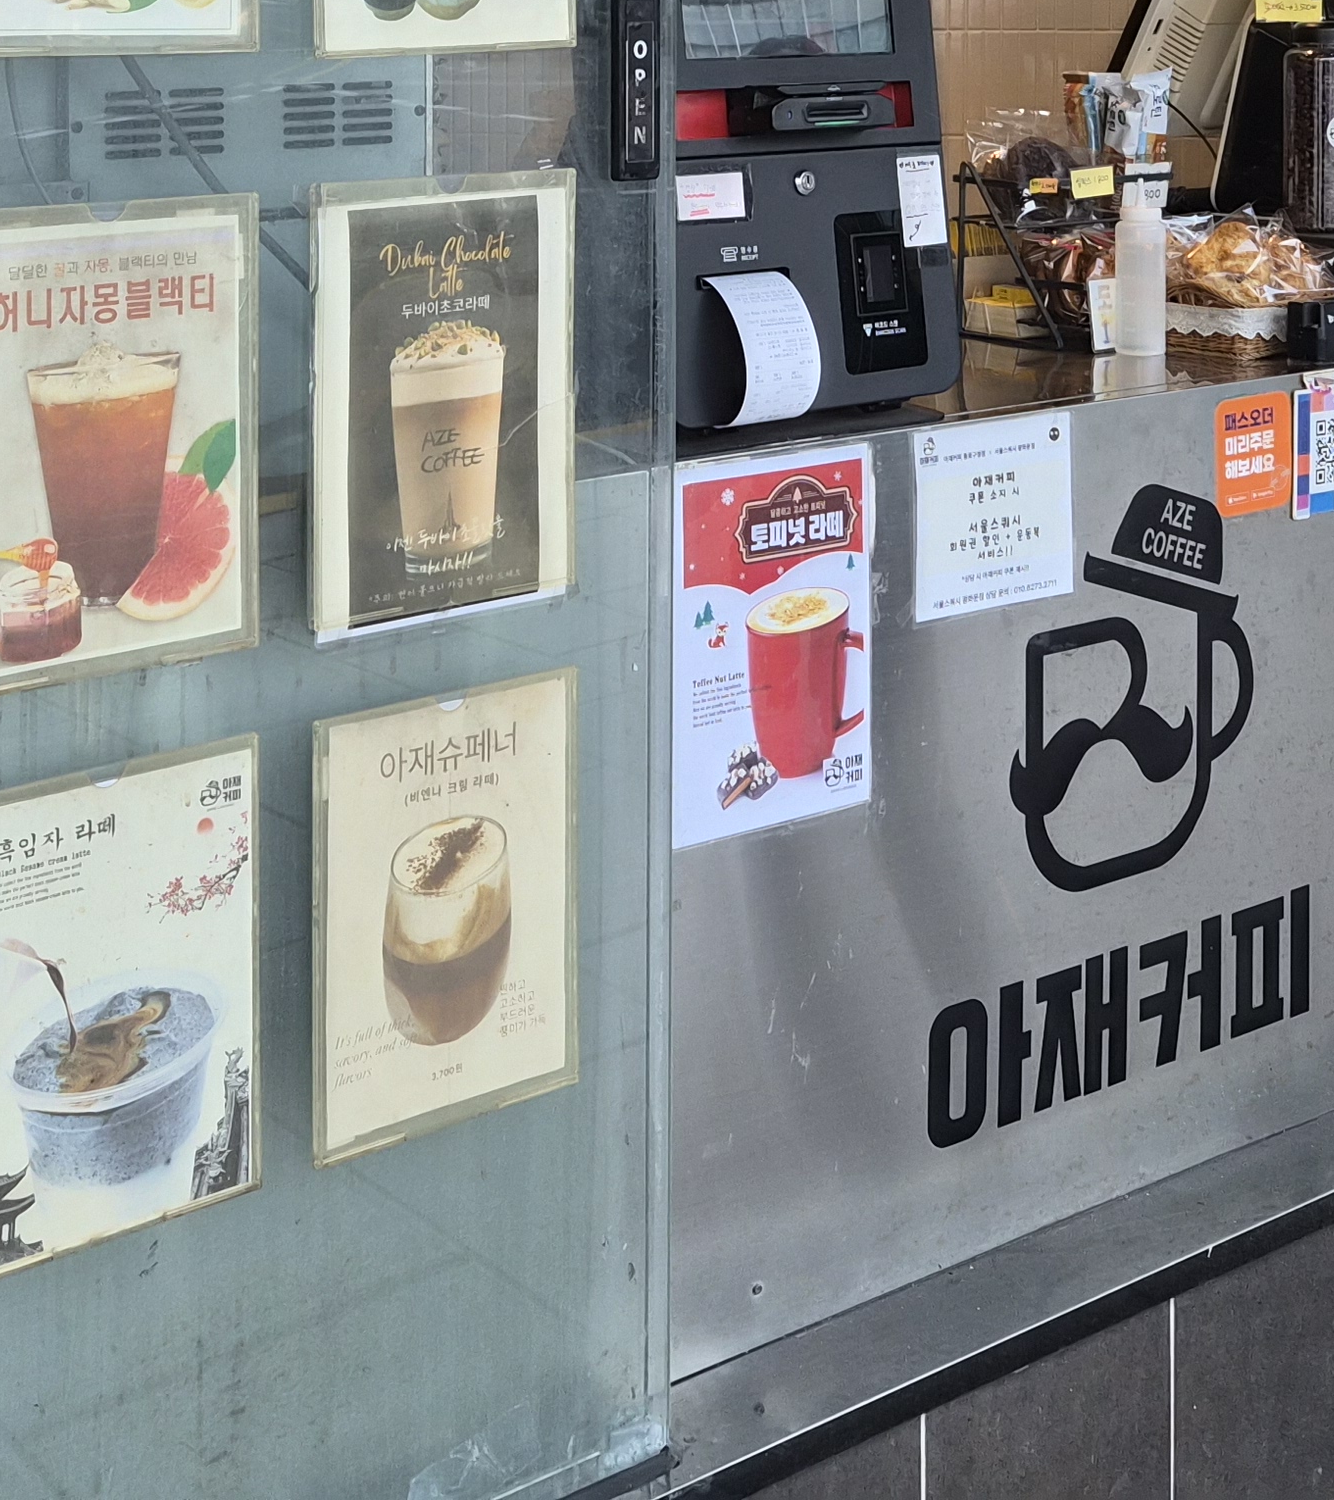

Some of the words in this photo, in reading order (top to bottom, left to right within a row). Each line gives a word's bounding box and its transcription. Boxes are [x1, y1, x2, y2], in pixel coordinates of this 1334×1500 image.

[632, 40, 650, 145] OPEN
[8, 263, 47, 281] 달달한
[118, 253, 168, 271] 블랙티의
[380, 240, 436, 277] Dubai
[441, 232, 514, 271] Chocolate
[429, 266, 467, 299] Latte
[401, 294, 490, 319] 두바이초코라떼
[1224, 407, 1274, 431] 패스오더
[422, 428, 460, 451] AZE
[1225, 430, 1275, 455] 미리주문
[421, 447, 485, 473] COFFEE
[1225, 454, 1275, 479] 해보세요
[972, 471, 1015, 487] 아재커피
[969, 491, 984, 505] 쿠폰
[990, 489, 1006, 500] 소지
[1012, 486, 1019, 496] 시
[1159, 497, 1195, 532] AZE
[750, 519, 807, 552] 토피넛
[808, 510, 845, 542] 라떼
[950, 537, 977, 552] 회원권
[982, 534, 1000, 548] 할인
[1141, 527, 1207, 570] COFFEE
[714, 673, 727, 684] Nut
[728, 670, 745, 683] Latte
[379, 721, 517, 783] 아재슈페너
[844, 753, 863, 770] 아재
[844, 768, 863, 783] 커피
[404, 784, 442, 807] (비엔나
[447, 778, 467, 794] 크림
[473, 772, 499, 787] 라떼)
[75, 813, 116, 843] 라떼
[927, 883, 1311, 1149] 아재커피
[353, 1027, 373, 1049] full
